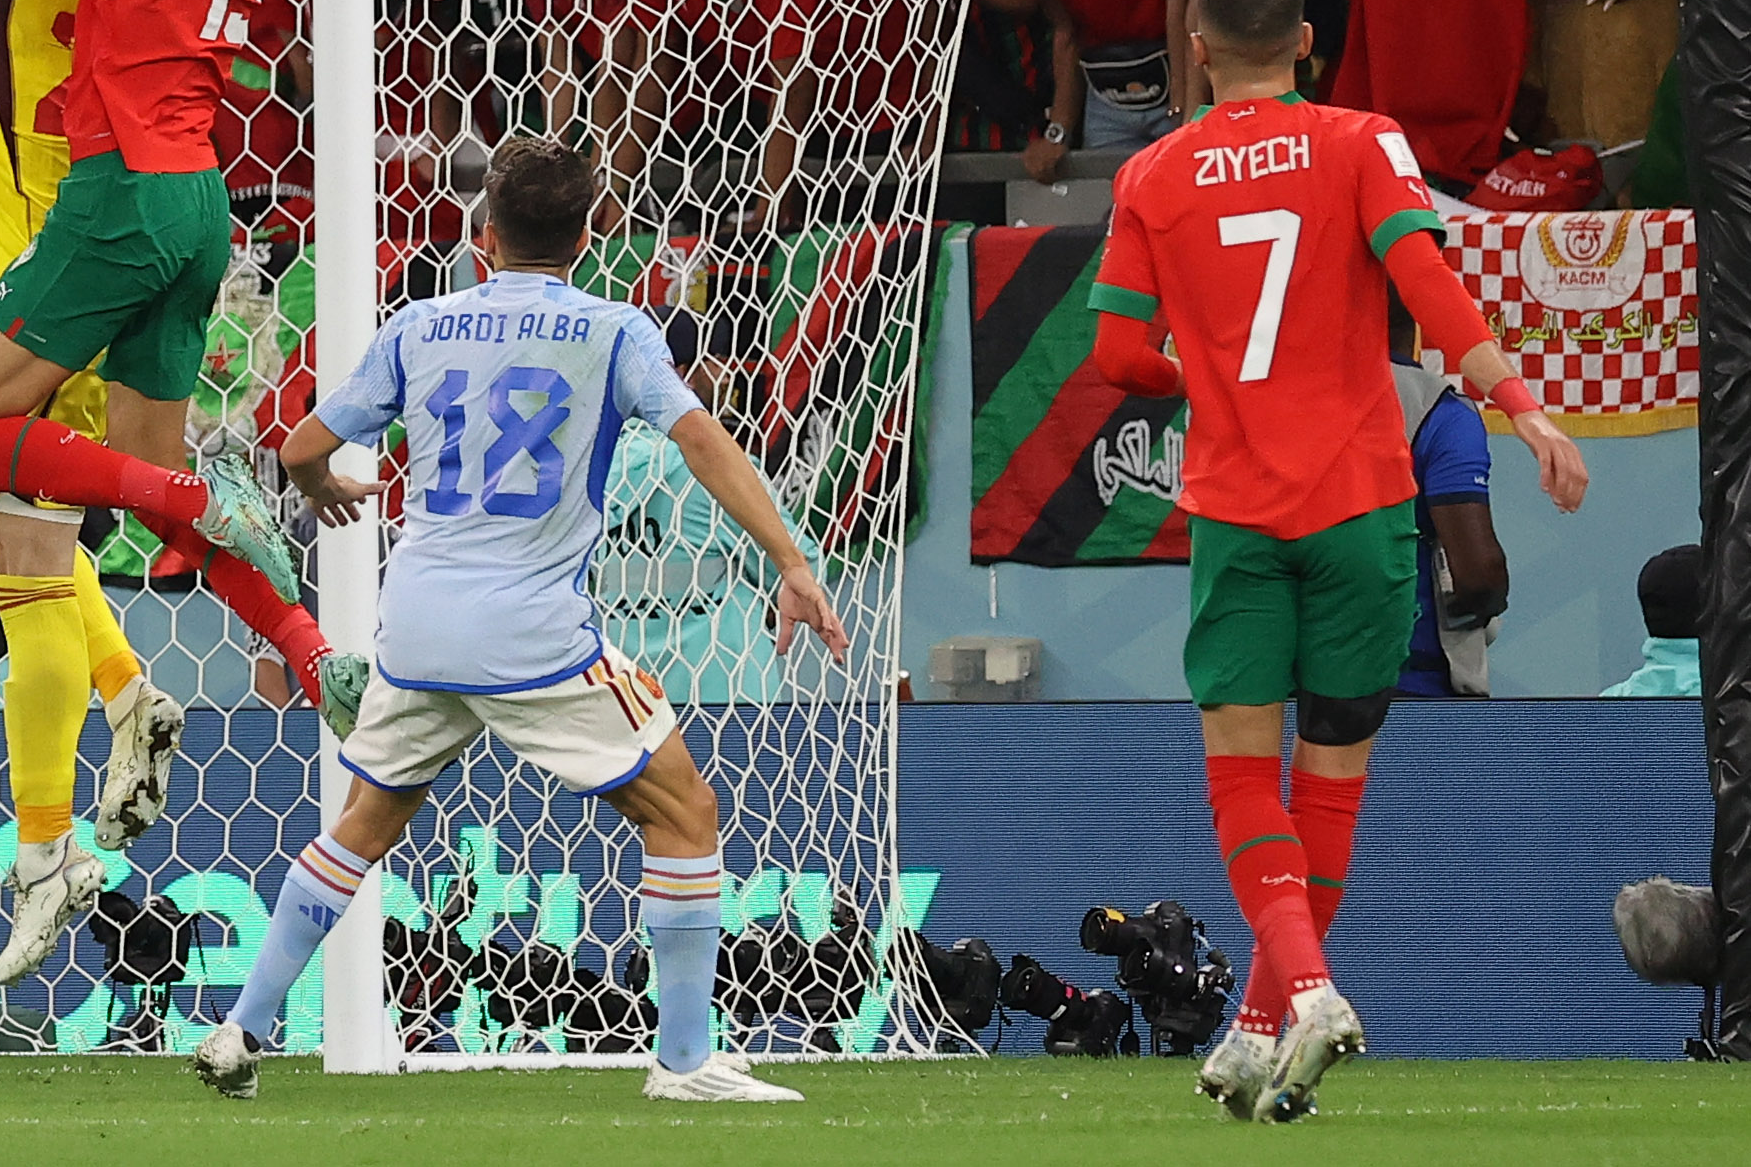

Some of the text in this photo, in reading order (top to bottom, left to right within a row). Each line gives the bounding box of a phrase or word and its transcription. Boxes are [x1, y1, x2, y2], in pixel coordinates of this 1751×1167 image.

[1193, 134, 1310, 186] ZIYECH
[1217, 208, 1302, 382] 7
[1558, 269, 1607, 285] KACM
[420, 312, 591, 344] JORDI ALBA
[424, 366, 574, 520] 18
